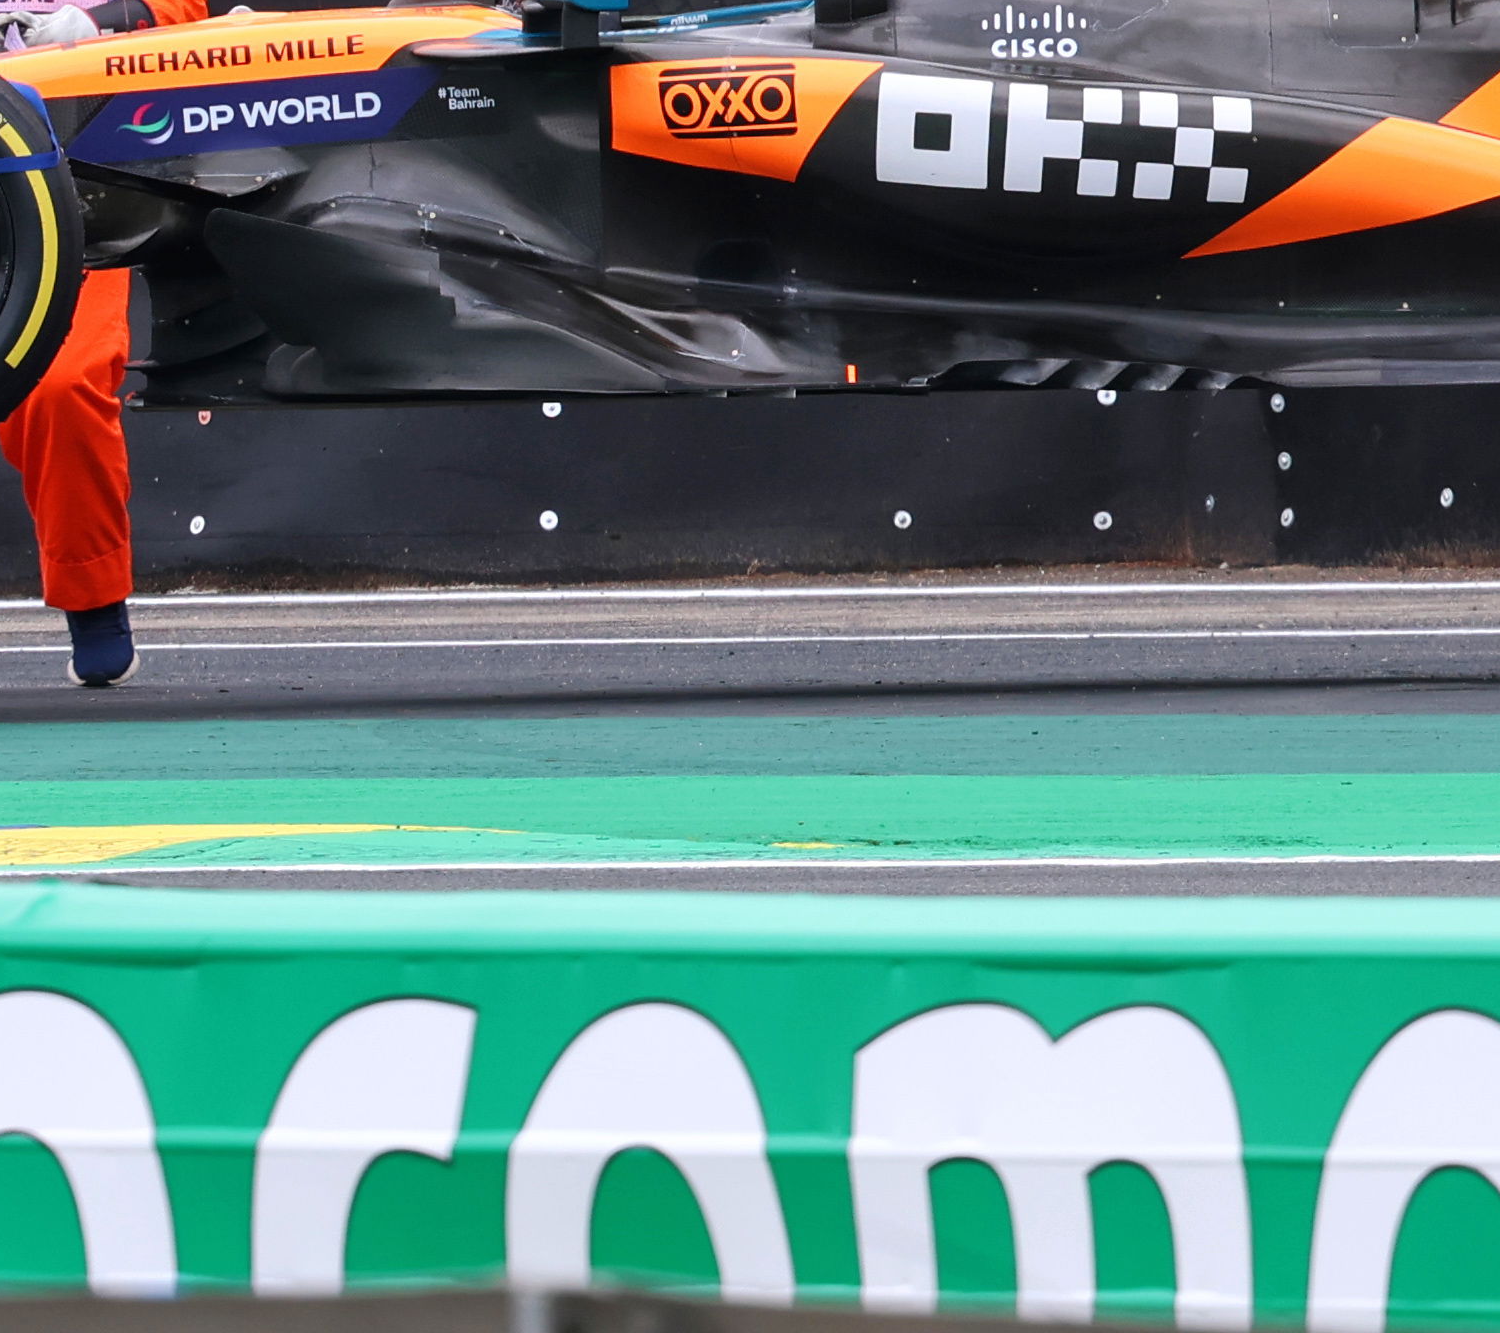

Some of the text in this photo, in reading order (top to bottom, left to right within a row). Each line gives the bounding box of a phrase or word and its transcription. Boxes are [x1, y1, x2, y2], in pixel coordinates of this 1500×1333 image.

[105, 34, 364, 76] RICHARD MILLE
[182, 91, 382, 134] DP WORLD
[438, 86, 480, 100] #Team
[448, 96, 495, 111] Bahrain
[664, 76, 792, 126] OXXO
